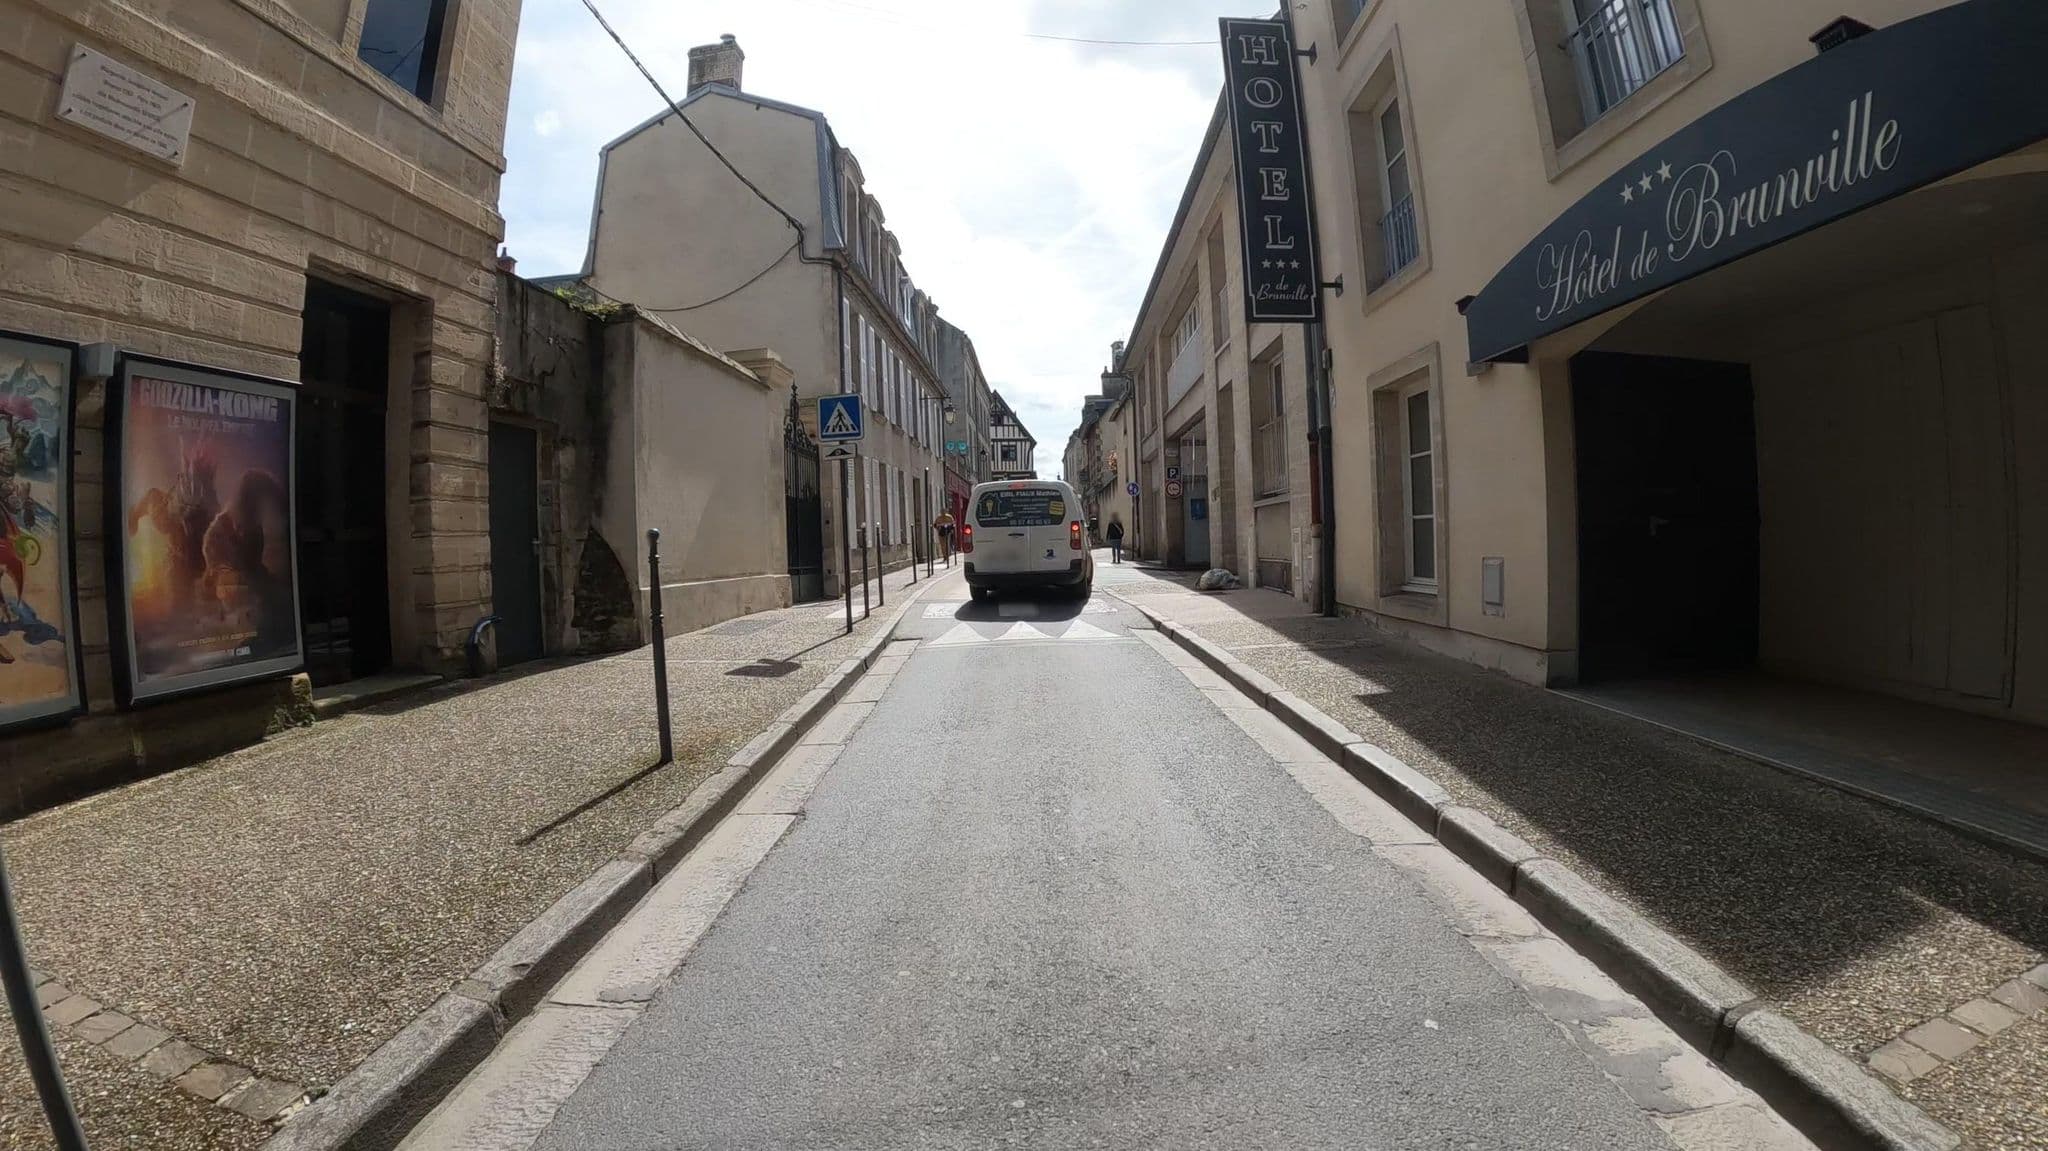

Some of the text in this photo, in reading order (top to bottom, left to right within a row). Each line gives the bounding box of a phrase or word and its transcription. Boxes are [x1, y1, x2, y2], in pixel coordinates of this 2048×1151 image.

[1239, 35, 1295, 250] HOTEL
[1536, 90, 1903, 322] Hôtel de Brunville
[1256, 283, 1310, 301] Brunville
[1275, 274, 1289, 291] de
